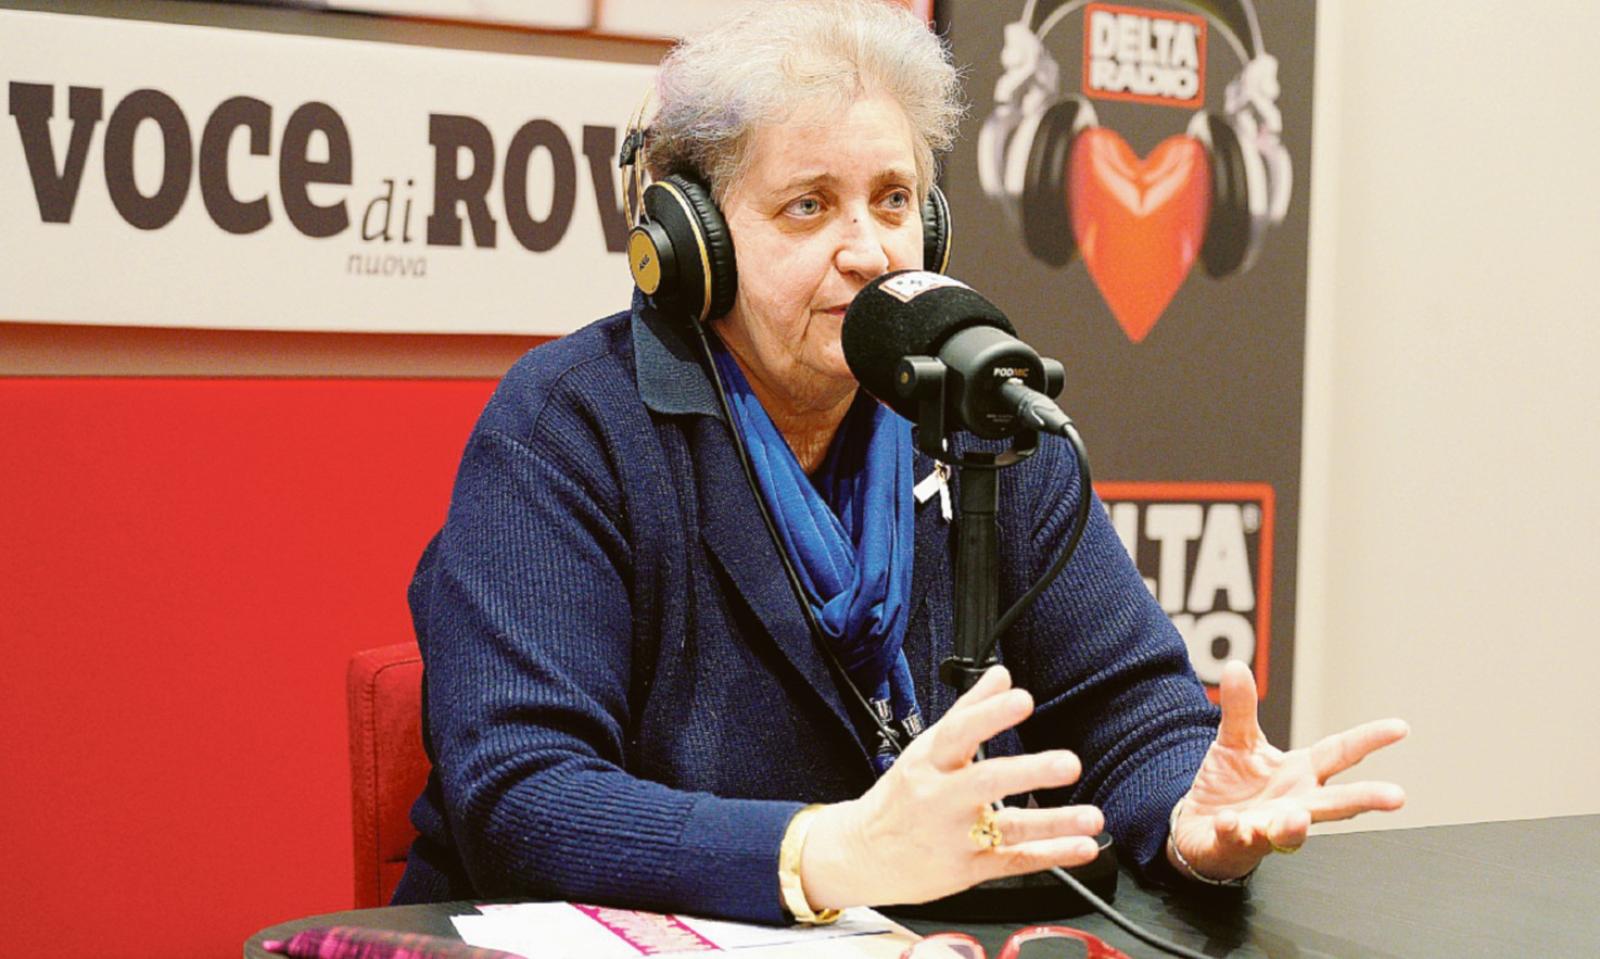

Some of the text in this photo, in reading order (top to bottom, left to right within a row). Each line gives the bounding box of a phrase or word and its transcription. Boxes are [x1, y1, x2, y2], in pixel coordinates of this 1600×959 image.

[1090, 10, 1199, 70] DELTA
[1089, 59, 1199, 100] RADIO
[361, 178, 413, 243] di
[346, 252, 428, 277] nuova
